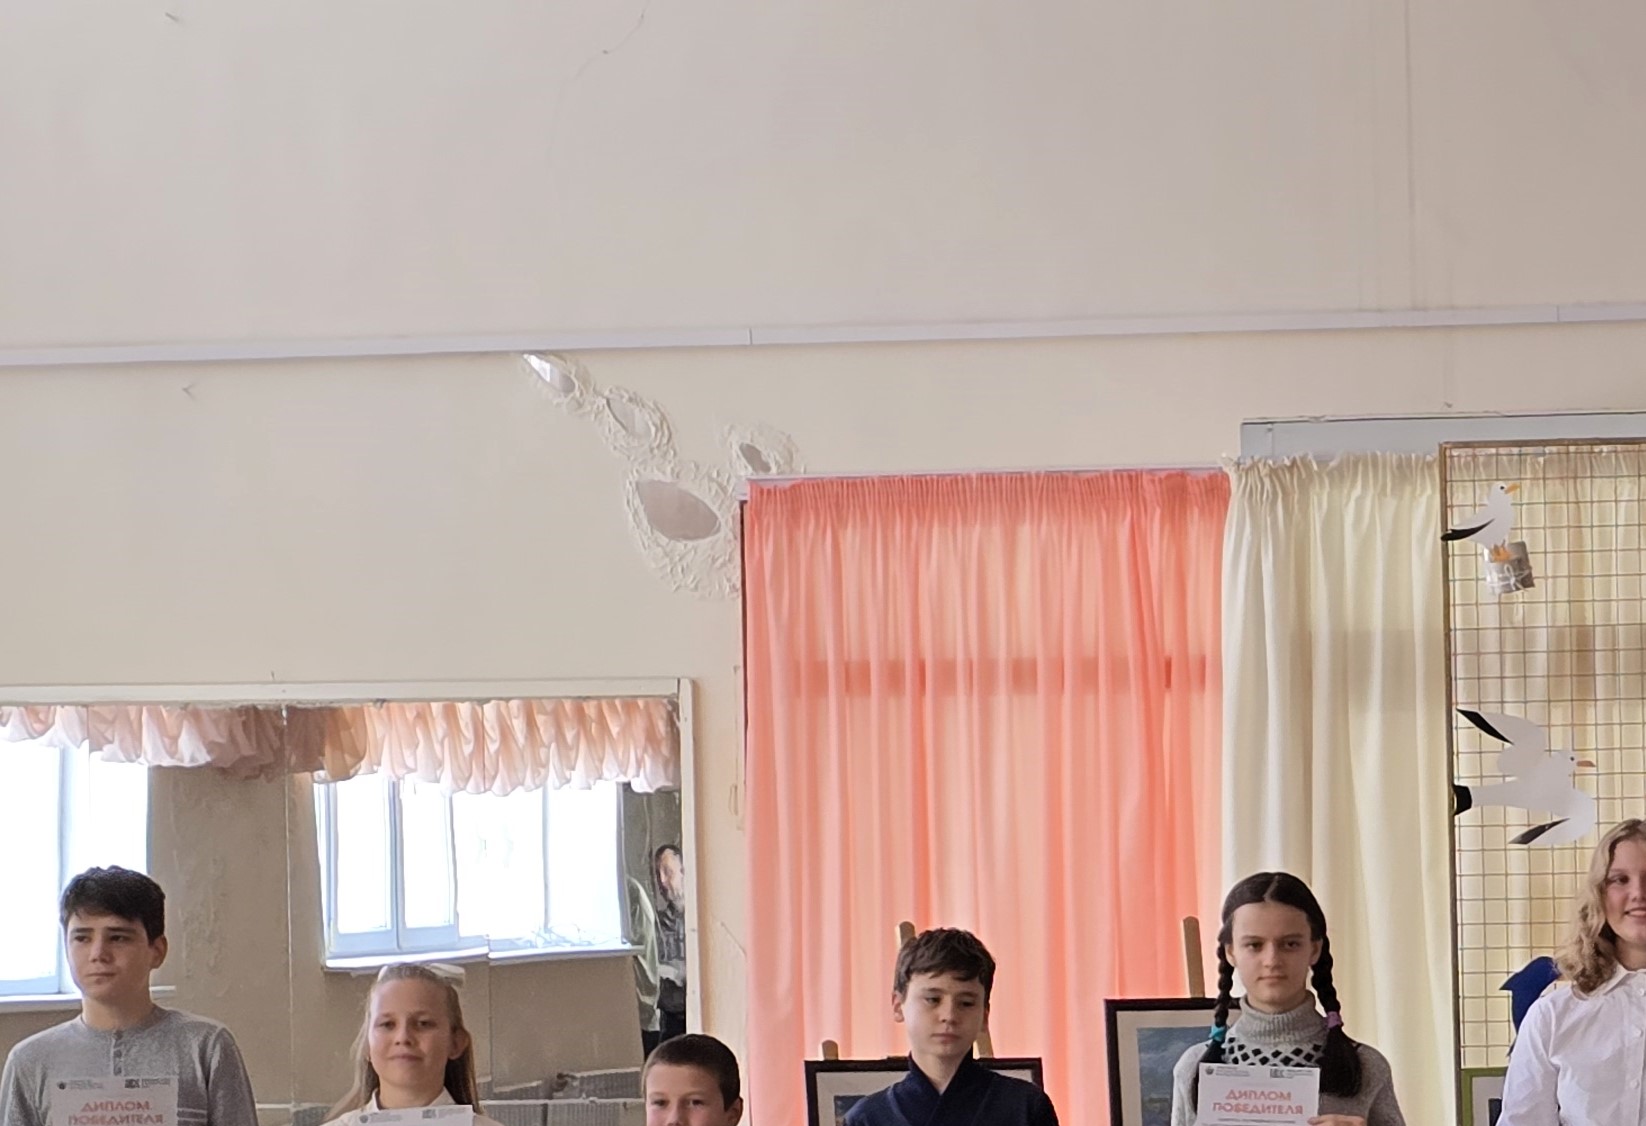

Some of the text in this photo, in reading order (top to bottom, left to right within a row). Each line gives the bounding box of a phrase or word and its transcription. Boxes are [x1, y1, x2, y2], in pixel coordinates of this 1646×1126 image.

[1225, 1089, 1292, 1101] ДИПЛОМ
[81, 1100, 151, 1112] ДИПЛОМ
[1213, 1102, 1304, 1115] ПОБЕДИТЕЛЯ
[68, 1114, 164, 1126] ПОБЕДИТЕЛЯ
